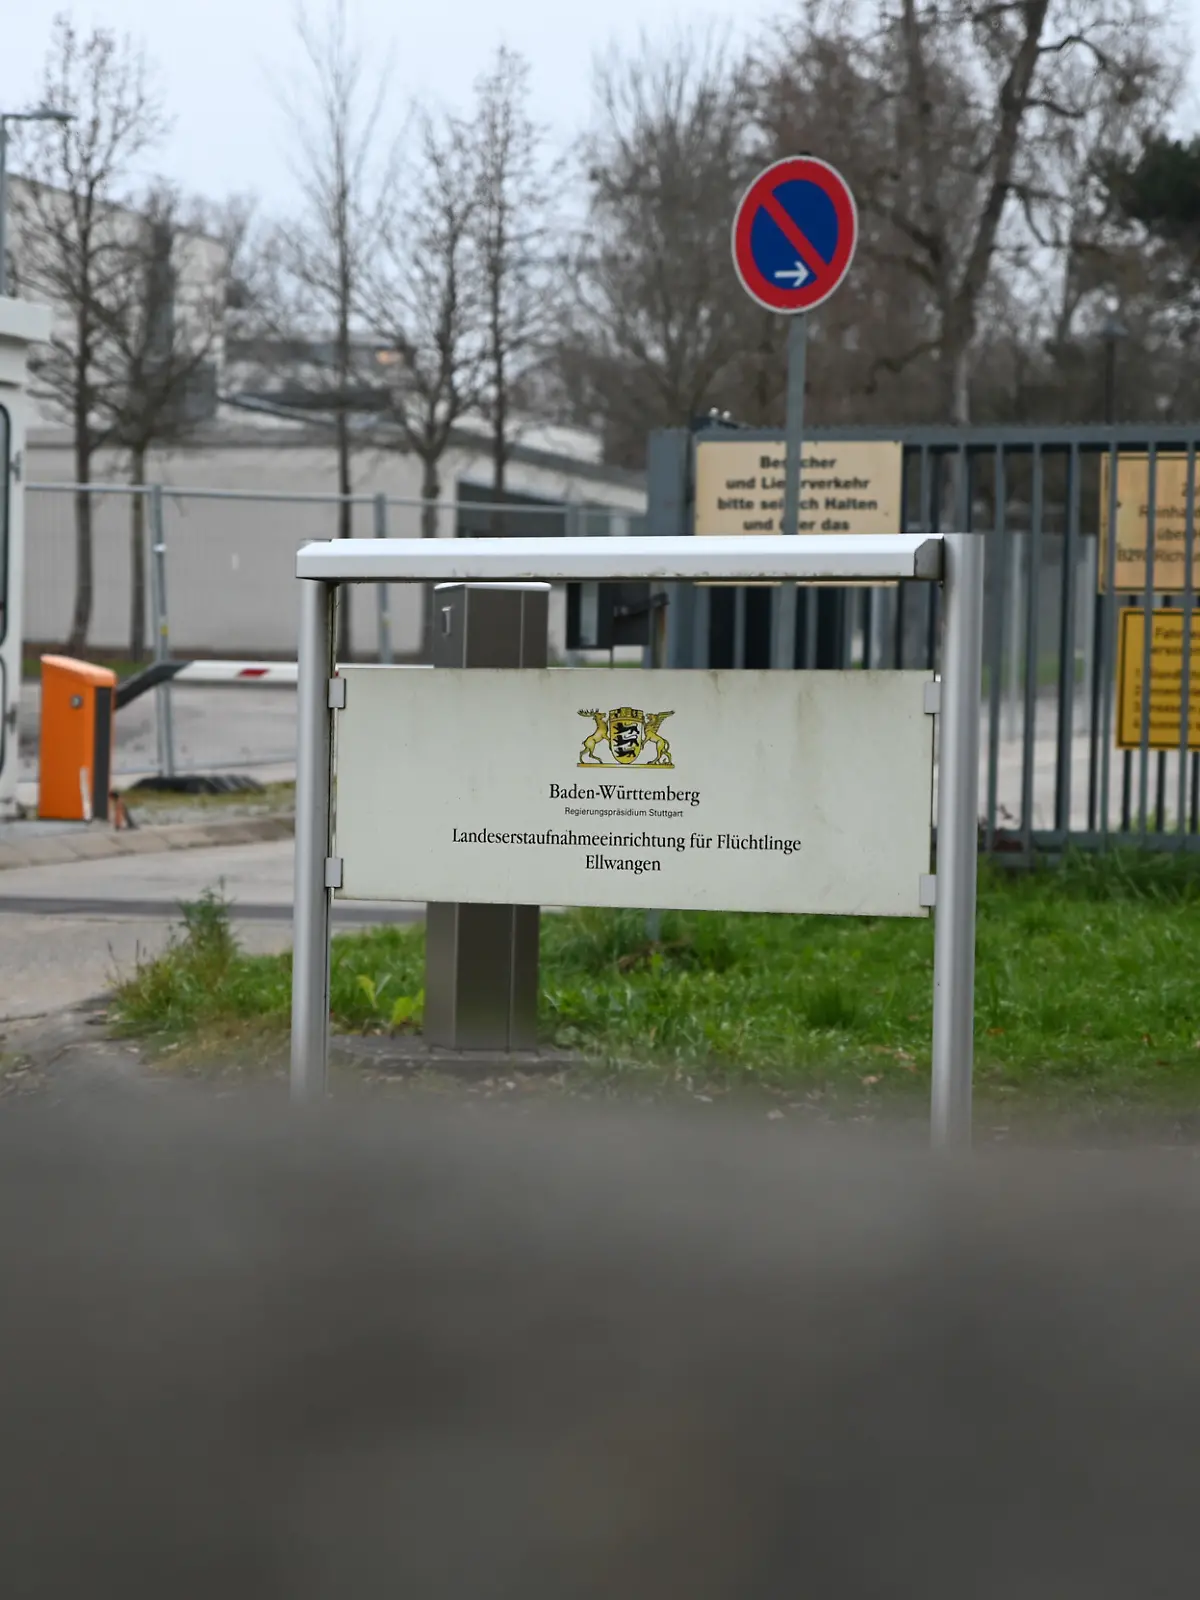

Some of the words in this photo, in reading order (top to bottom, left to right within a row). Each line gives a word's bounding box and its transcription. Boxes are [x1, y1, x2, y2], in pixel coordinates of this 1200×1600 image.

[760, 456, 837, 469] Bescher
[725, 476, 756, 490] und
[761, 476, 870, 490] Lierverkehr
[717, 497, 754, 510] bitte
[760, 497, 819, 510] seich
[825, 497, 878, 510] Halten
[743, 517, 774, 531] und
[821, 517, 850, 531] das
[549, 783, 701, 807] Baden-Württemberg
[564, 807, 647, 818] Regierungspräsidium
[649, 808, 684, 818] Stuttgart
[452, 828, 686, 852] Landeserstaufnahmeeinrichtung
[690, 833, 713, 849] für
[717, 834, 802, 855] Flüchtlinge
[585, 854, 662, 875] Ellwangen
